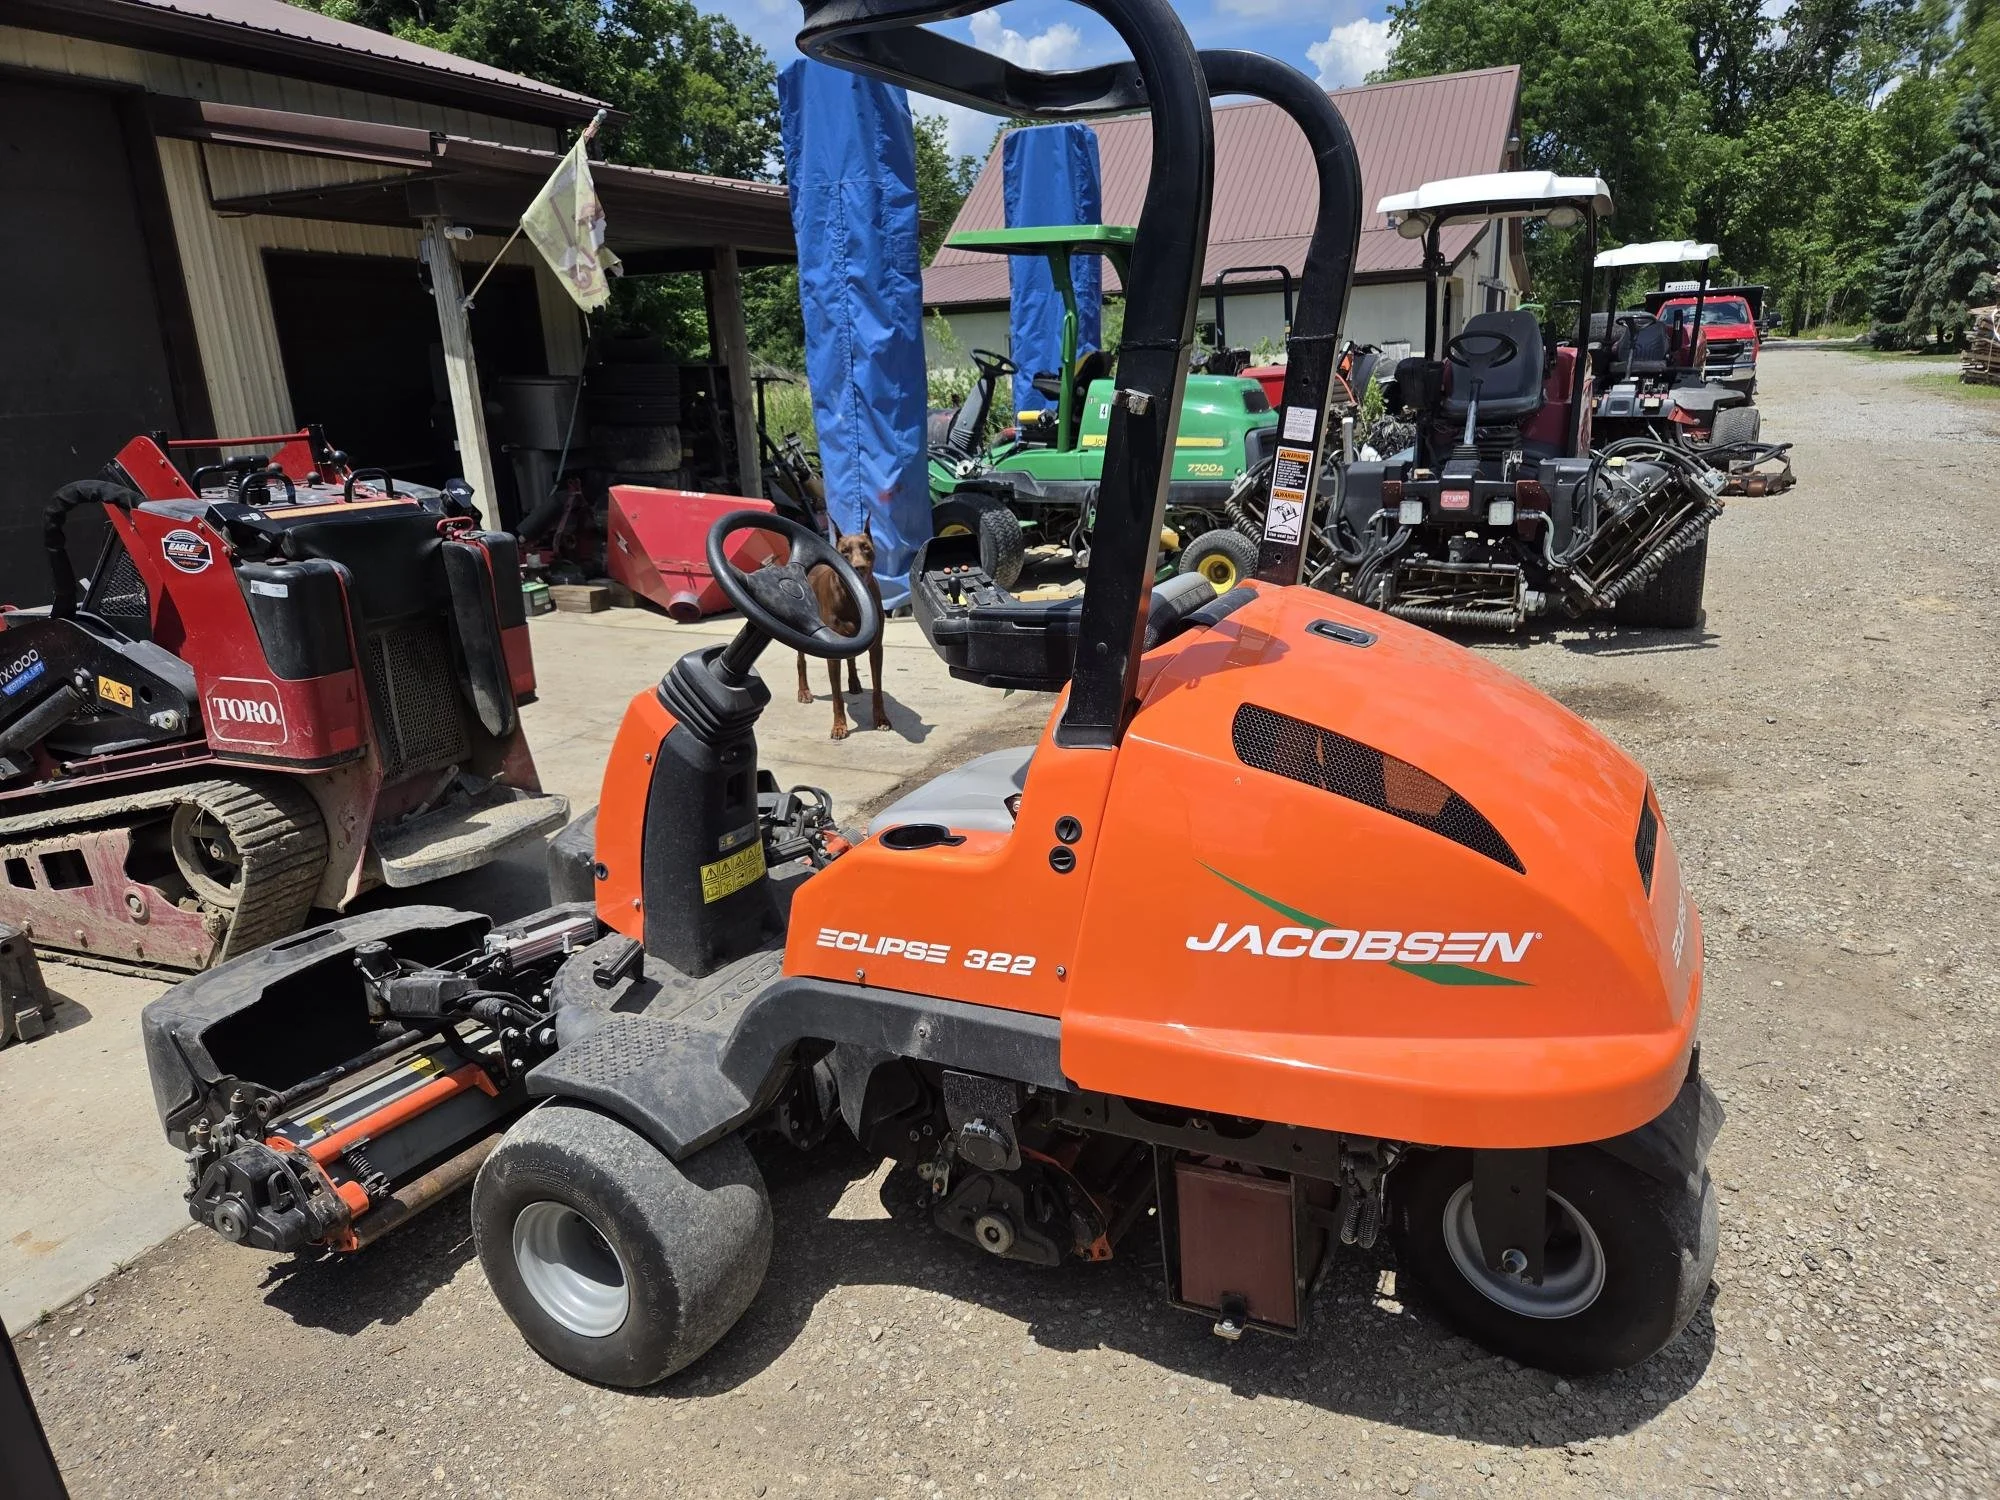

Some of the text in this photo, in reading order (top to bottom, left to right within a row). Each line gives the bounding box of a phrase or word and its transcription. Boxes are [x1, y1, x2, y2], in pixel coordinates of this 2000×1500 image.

[168, 542, 196, 553] EAGLE
[212, 697, 277, 725] TORO
[816, 927, 1037, 976] ECLIPSE 322
[1185, 922, 1536, 963] JACOBSEN
[702, 951, 785, 1021] JACO
